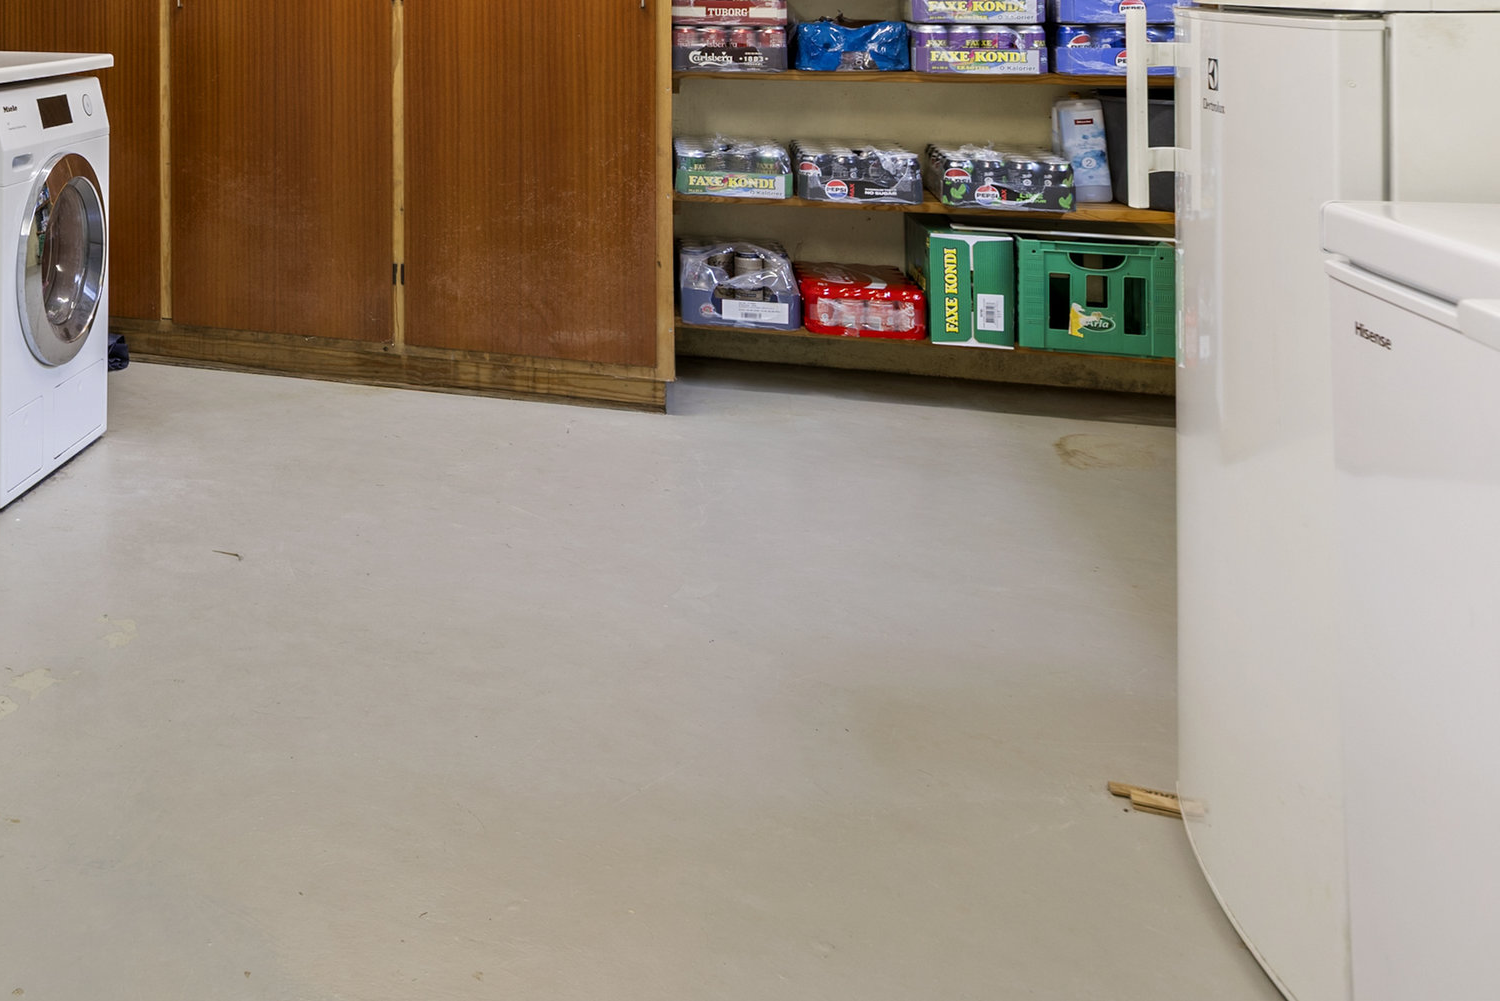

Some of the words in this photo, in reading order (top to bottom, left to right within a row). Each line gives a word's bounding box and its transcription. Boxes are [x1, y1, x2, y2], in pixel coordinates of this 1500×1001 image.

[707, 8, 748, 17] TUBORG
[928, 0, 968, 12] FAXE
[971, 0, 1027, 13] KONDI
[689, 50, 733, 66] Carlsberg
[930, 50, 970, 62] FAXE
[973, 51, 1028, 63] KONDI
[688, 175, 724, 186] FAXE
[728, 177, 775, 189] KONDI
[943, 248, 958, 294] KONDI
[945, 297, 959, 333] FAXE
[1087, 319, 1110, 329] Arla
[1355, 321, 1392, 350] Hisense
